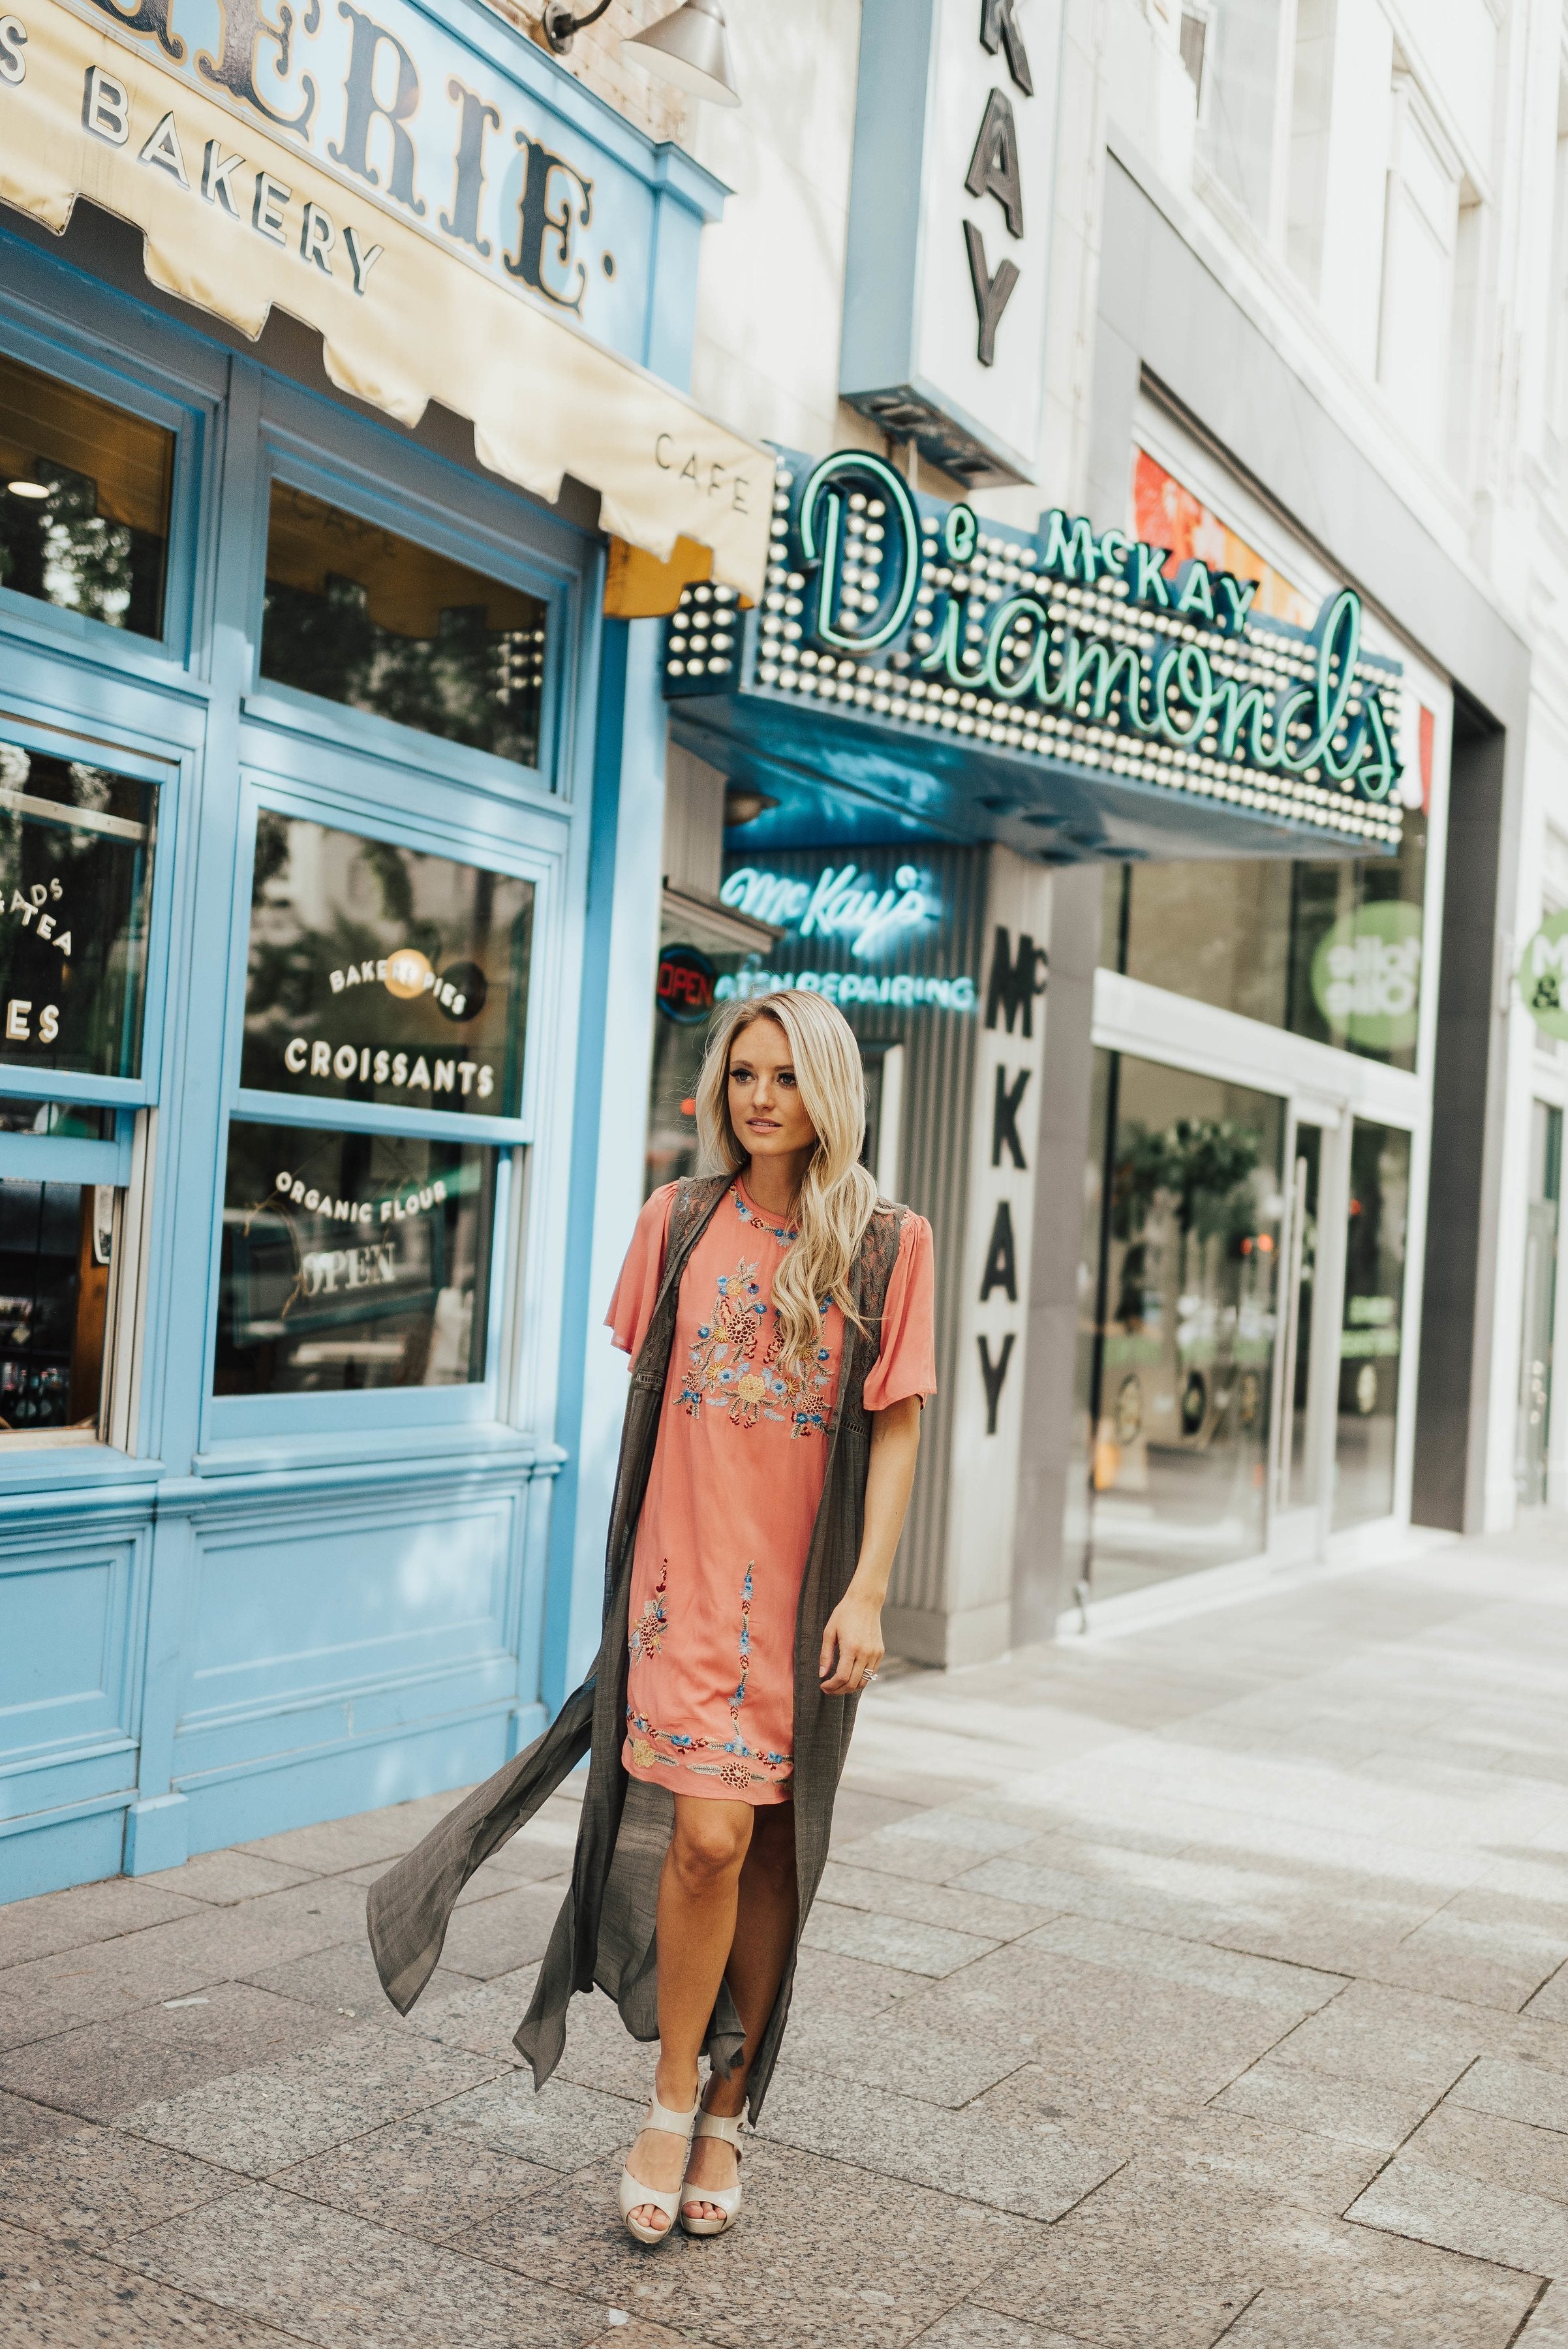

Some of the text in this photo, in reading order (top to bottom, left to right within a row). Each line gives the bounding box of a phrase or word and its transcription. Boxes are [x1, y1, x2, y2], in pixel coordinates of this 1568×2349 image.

[82, 65, 386, 296] BAKERY
[655, 433, 748, 514] CAFE
[797, 450, 1398, 801] Diamonds
[0, 878, 63, 914] ADS
[22, 901, 72, 957] TEA
[423, 970, 467, 1016] PIES
[658, 962, 713, 1007] OPEN
[795, 970, 975, 1011] REPAIRING
[284, 1037, 494, 1098] CROISSANTS
[275, 1171, 447, 1223] ORGANIC FLOUR
[301, 1242, 395, 1298] OPEN
